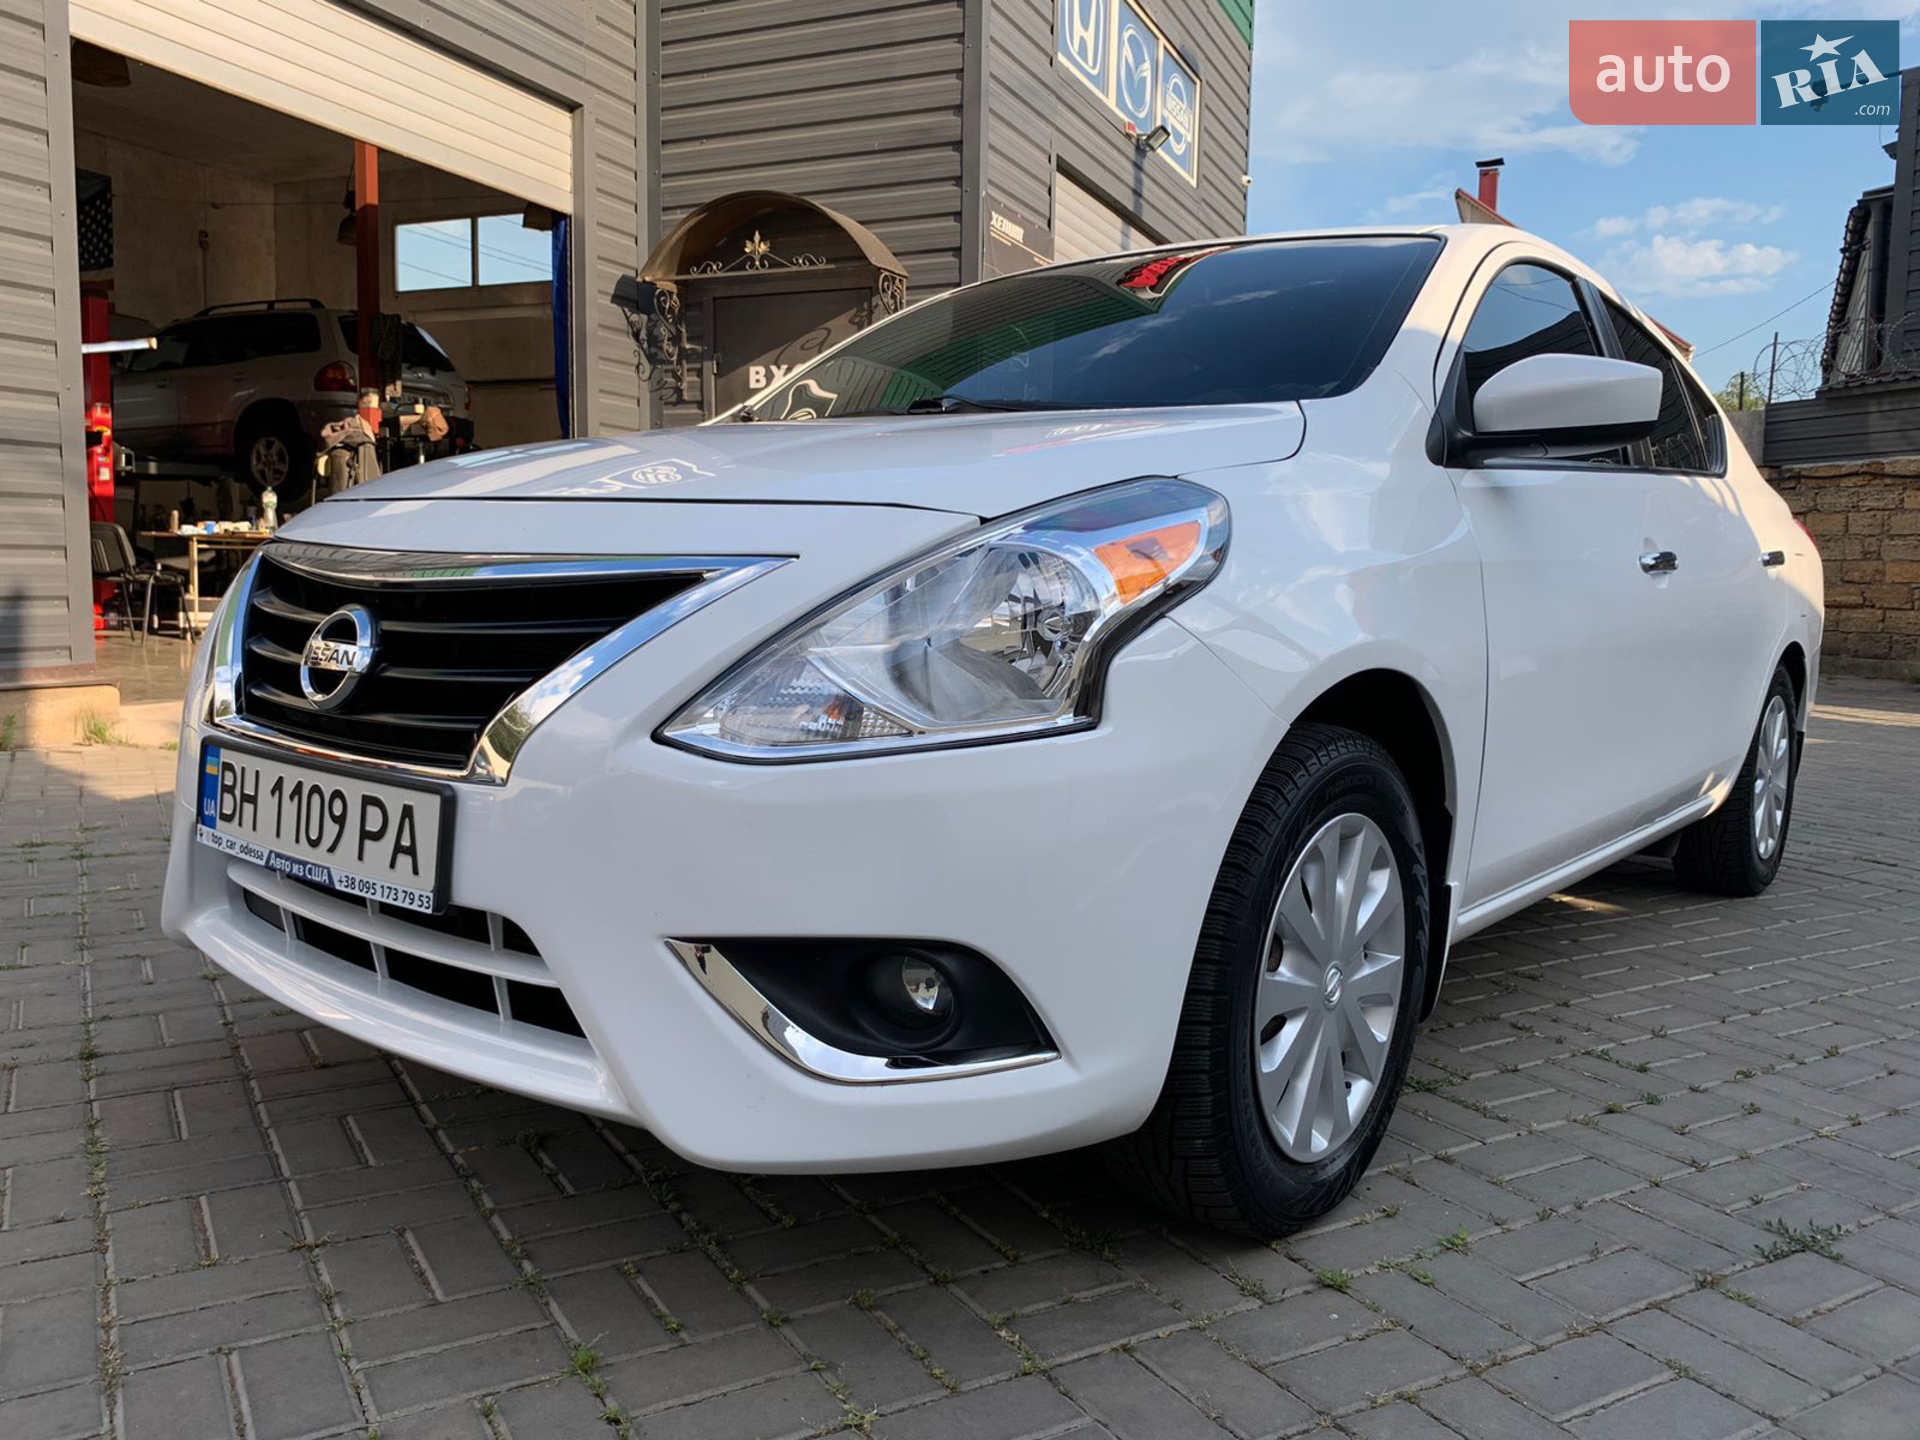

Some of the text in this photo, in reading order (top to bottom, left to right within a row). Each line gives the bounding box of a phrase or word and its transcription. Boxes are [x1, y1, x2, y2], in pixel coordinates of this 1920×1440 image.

[749, 363, 806, 389] ВХ
[204, 797, 216, 818] UA
[270, 775, 348, 853] 1109
[211, 831, 264, 861] top_car_odessa
[269, 853, 330, 885] Авто из США
[337, 875, 431, 910] +38 095 173 79 53
